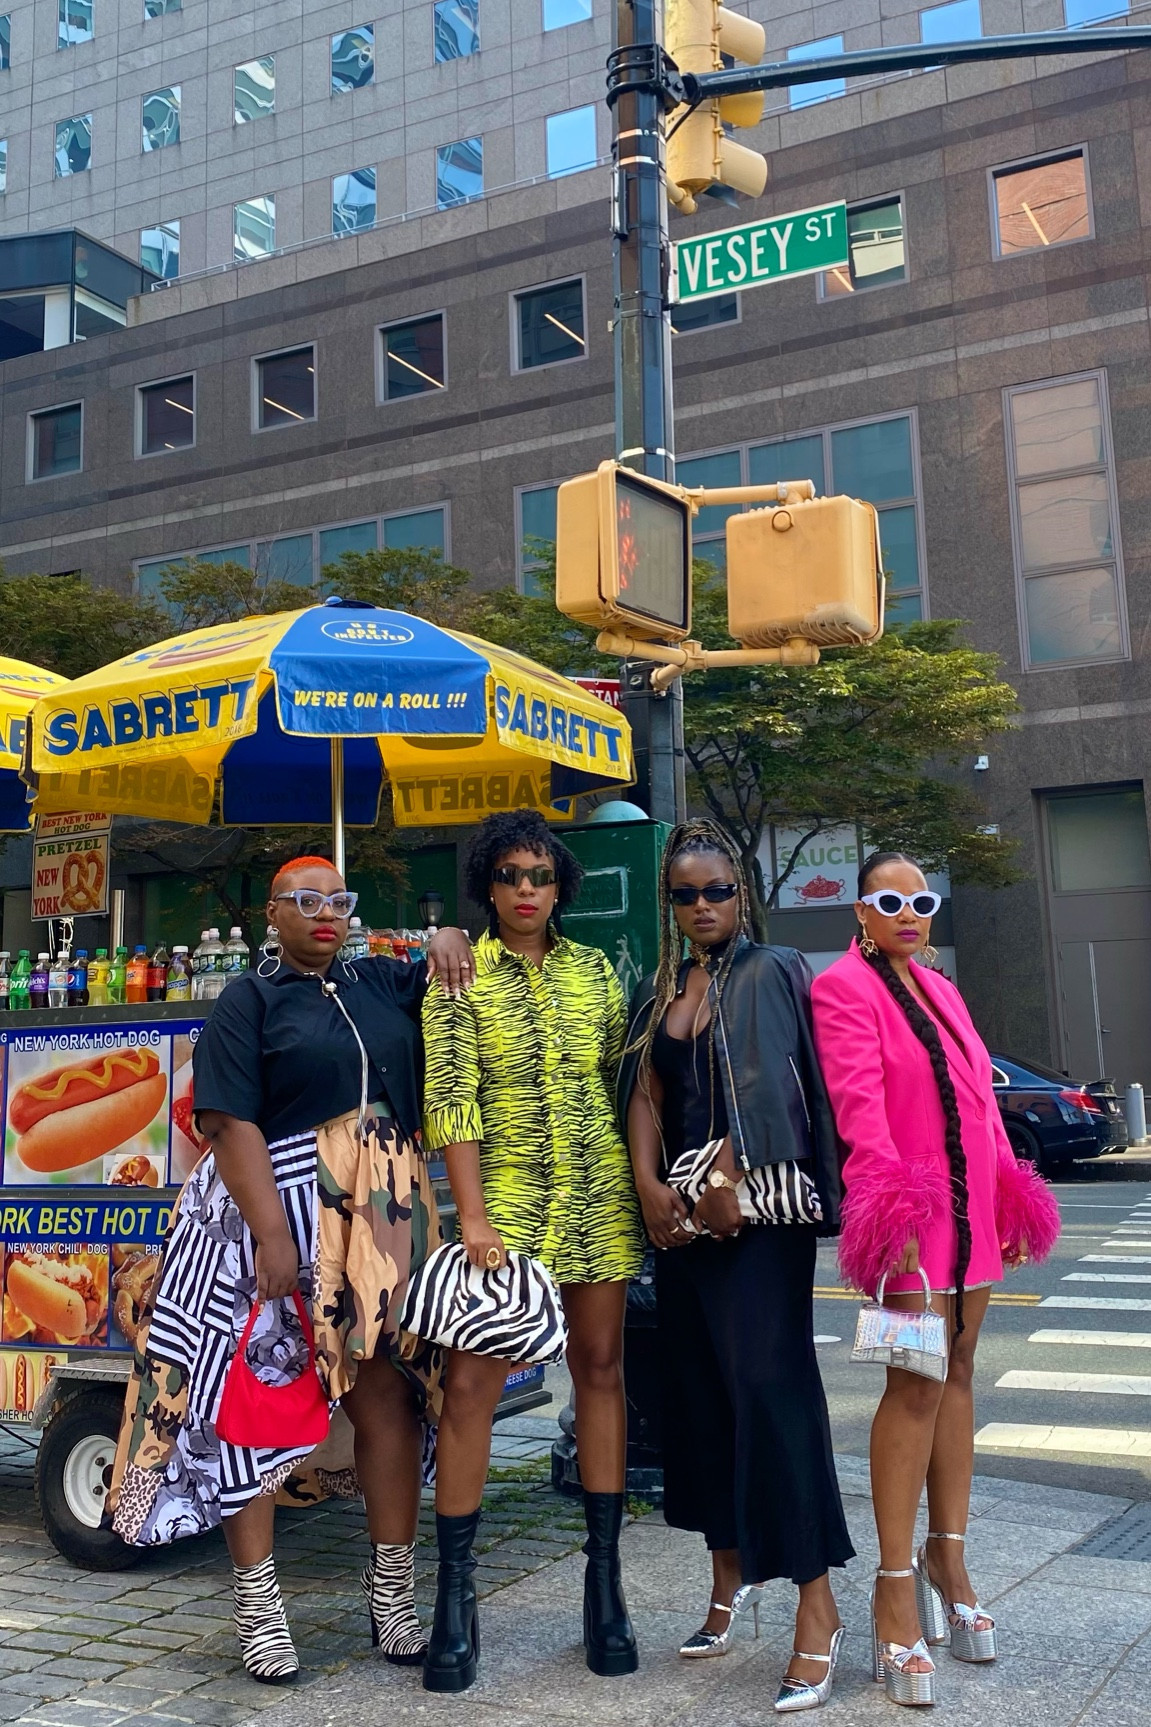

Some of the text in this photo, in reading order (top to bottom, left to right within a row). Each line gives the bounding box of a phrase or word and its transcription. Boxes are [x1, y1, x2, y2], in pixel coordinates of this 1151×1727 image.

[682, 212, 836, 292] VESEY ST
[293, 689, 467, 710] WE'RE ON A ROLL !!!
[43, 672, 257, 756] SABRETT
[495, 678, 622, 762] SABRETT
[42, 812, 107, 828] BEST NEW YORK
[54, 822, 91, 835] HOT DOG
[37, 837, 102, 857] PRETZEL
[779, 845, 858, 869] SAUCE
[36, 867, 60, 887] NEW
[33, 895, 61, 916] YORK
[14, 1036, 46, 1051] NEW
[49, 1034, 89, 1050] YORK
[94, 1032, 126, 1048] HOT
[128, 1030, 160, 1046] DOG
[38, 1207, 98, 1235] BEST
[102, 1207, 152, 1236] HOT
[7, 1242, 108, 1255] NEW YORK CHILI DOG
[524, 1367, 537, 1380] DOG
